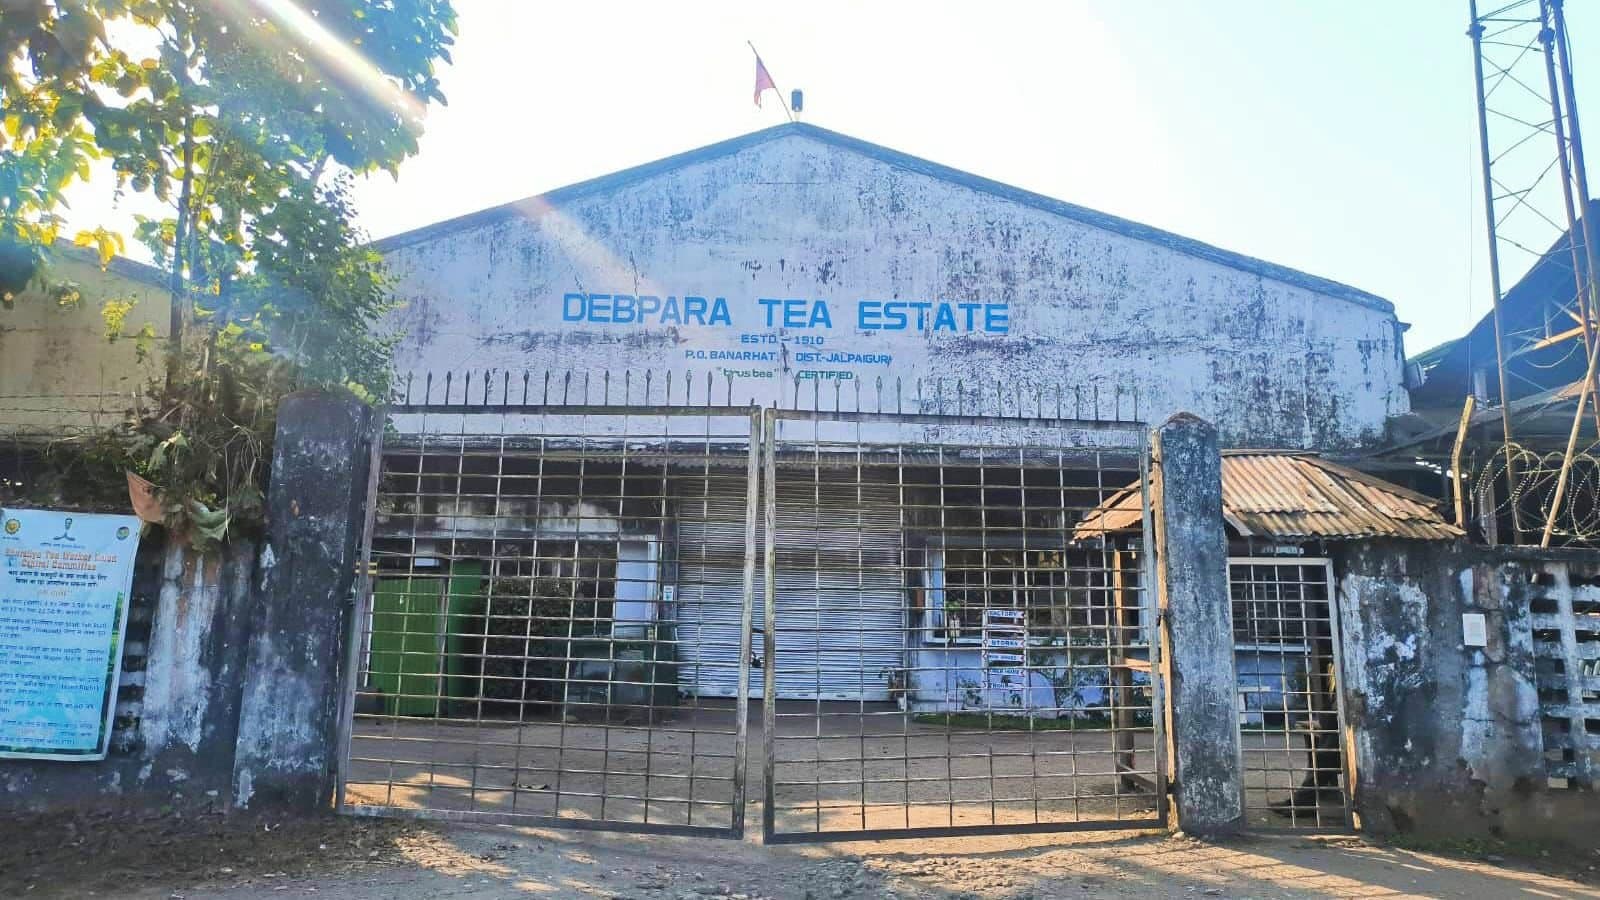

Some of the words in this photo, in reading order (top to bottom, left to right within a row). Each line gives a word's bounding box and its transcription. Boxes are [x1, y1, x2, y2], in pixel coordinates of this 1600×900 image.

[563, 293, 732, 325] DEBPARA
[758, 299, 833, 329] TEA
[857, 301, 1009, 332] ESTATE
[794, 336, 824, 345] 1910
[710, 350, 775, 361] BANARHAT
[798, 370, 853, 380] CERTIFIED
